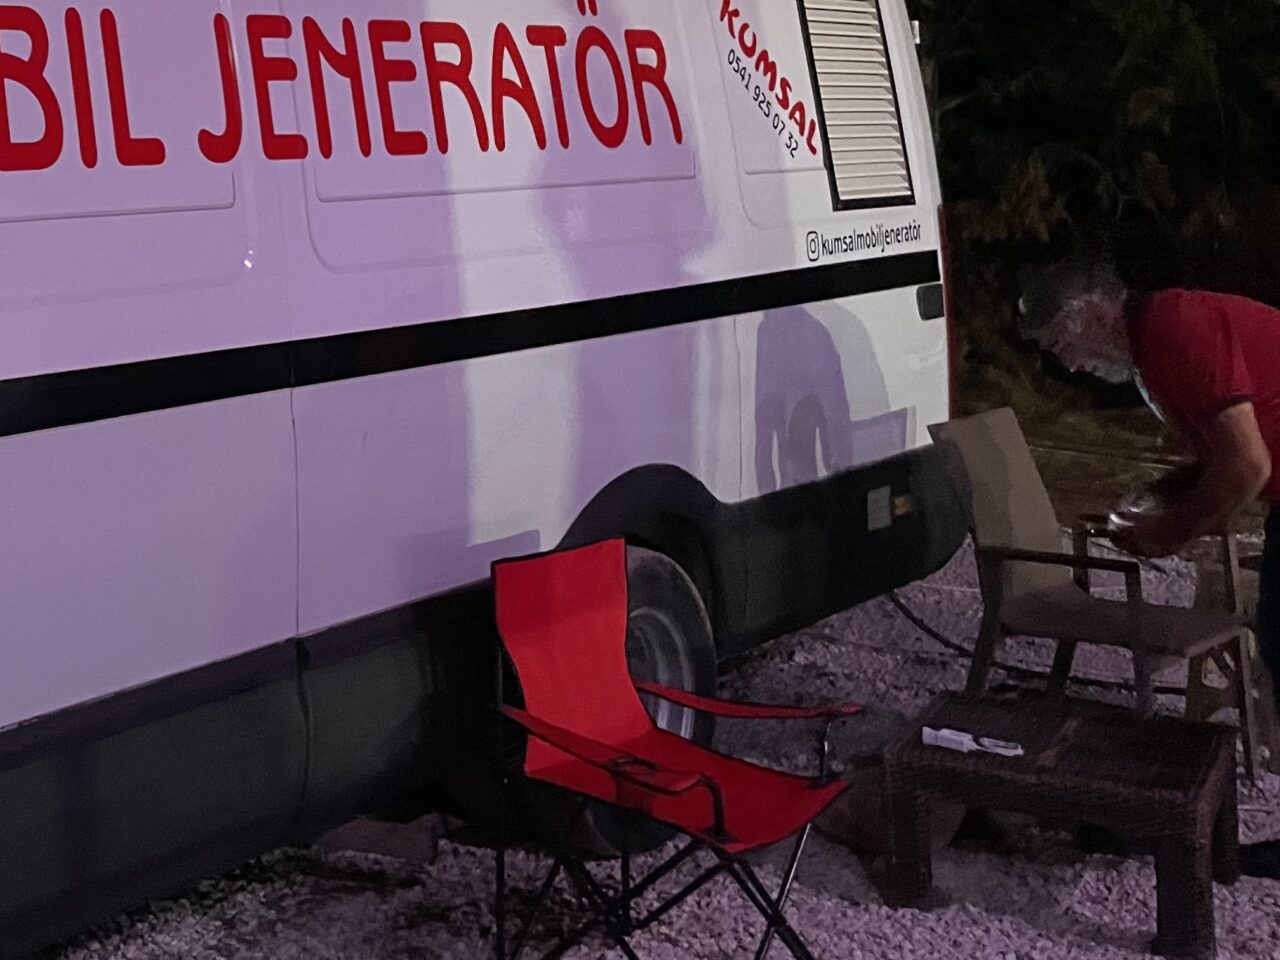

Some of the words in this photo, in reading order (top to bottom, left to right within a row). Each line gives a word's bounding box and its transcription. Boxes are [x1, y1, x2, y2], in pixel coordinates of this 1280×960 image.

[727, 49, 751, 91] 0541
[753, 85, 772, 118] 925
[772, 113, 785, 136] 07
[785, 131, 799, 158] 32
